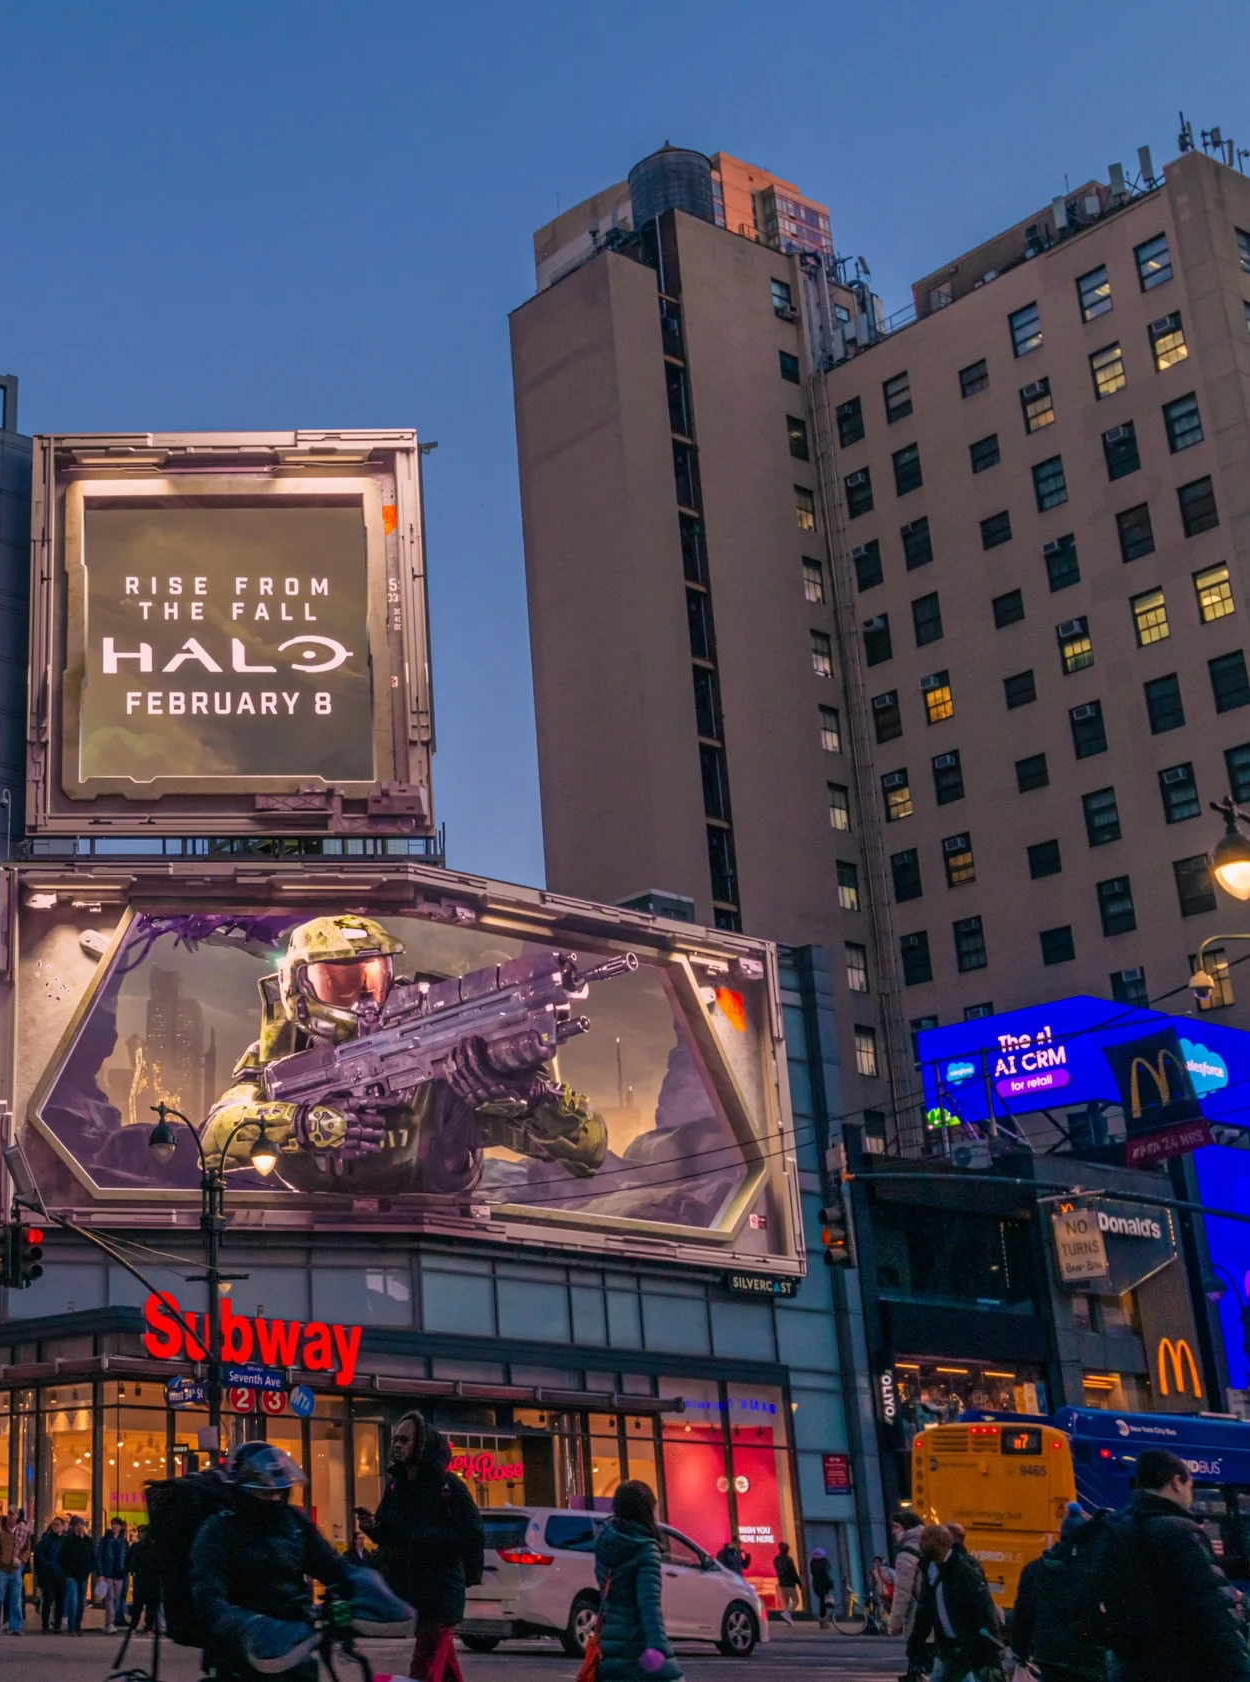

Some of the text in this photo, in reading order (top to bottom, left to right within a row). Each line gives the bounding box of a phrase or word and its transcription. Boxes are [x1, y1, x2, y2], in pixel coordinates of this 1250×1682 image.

[125, 576, 329, 596] RISE FROM
[139, 602, 317, 621] THE FALL
[102, 635, 354, 674] HALO
[126, 692, 332, 715] FEBRUARY 8
[997, 1025, 1053, 1053] The #1
[994, 1045, 1067, 1077] AI CRM
[1186, 1059, 1225, 1079] alesforce
[1010, 1074, 1053, 1092] for retail
[1066, 1219, 1088, 1235] NO
[1097, 1211, 1162, 1239] Donald's
[1061, 1241, 1100, 1257] TURNS
[143, 1291, 363, 1386] Subway
[228, 1370, 281, 1388] Seventh Ave
[236, 1387, 312, 1413] 2 3 MTA
[475, 1451, 525, 1483] Rose
[756, 1526, 771, 1535] YOU
